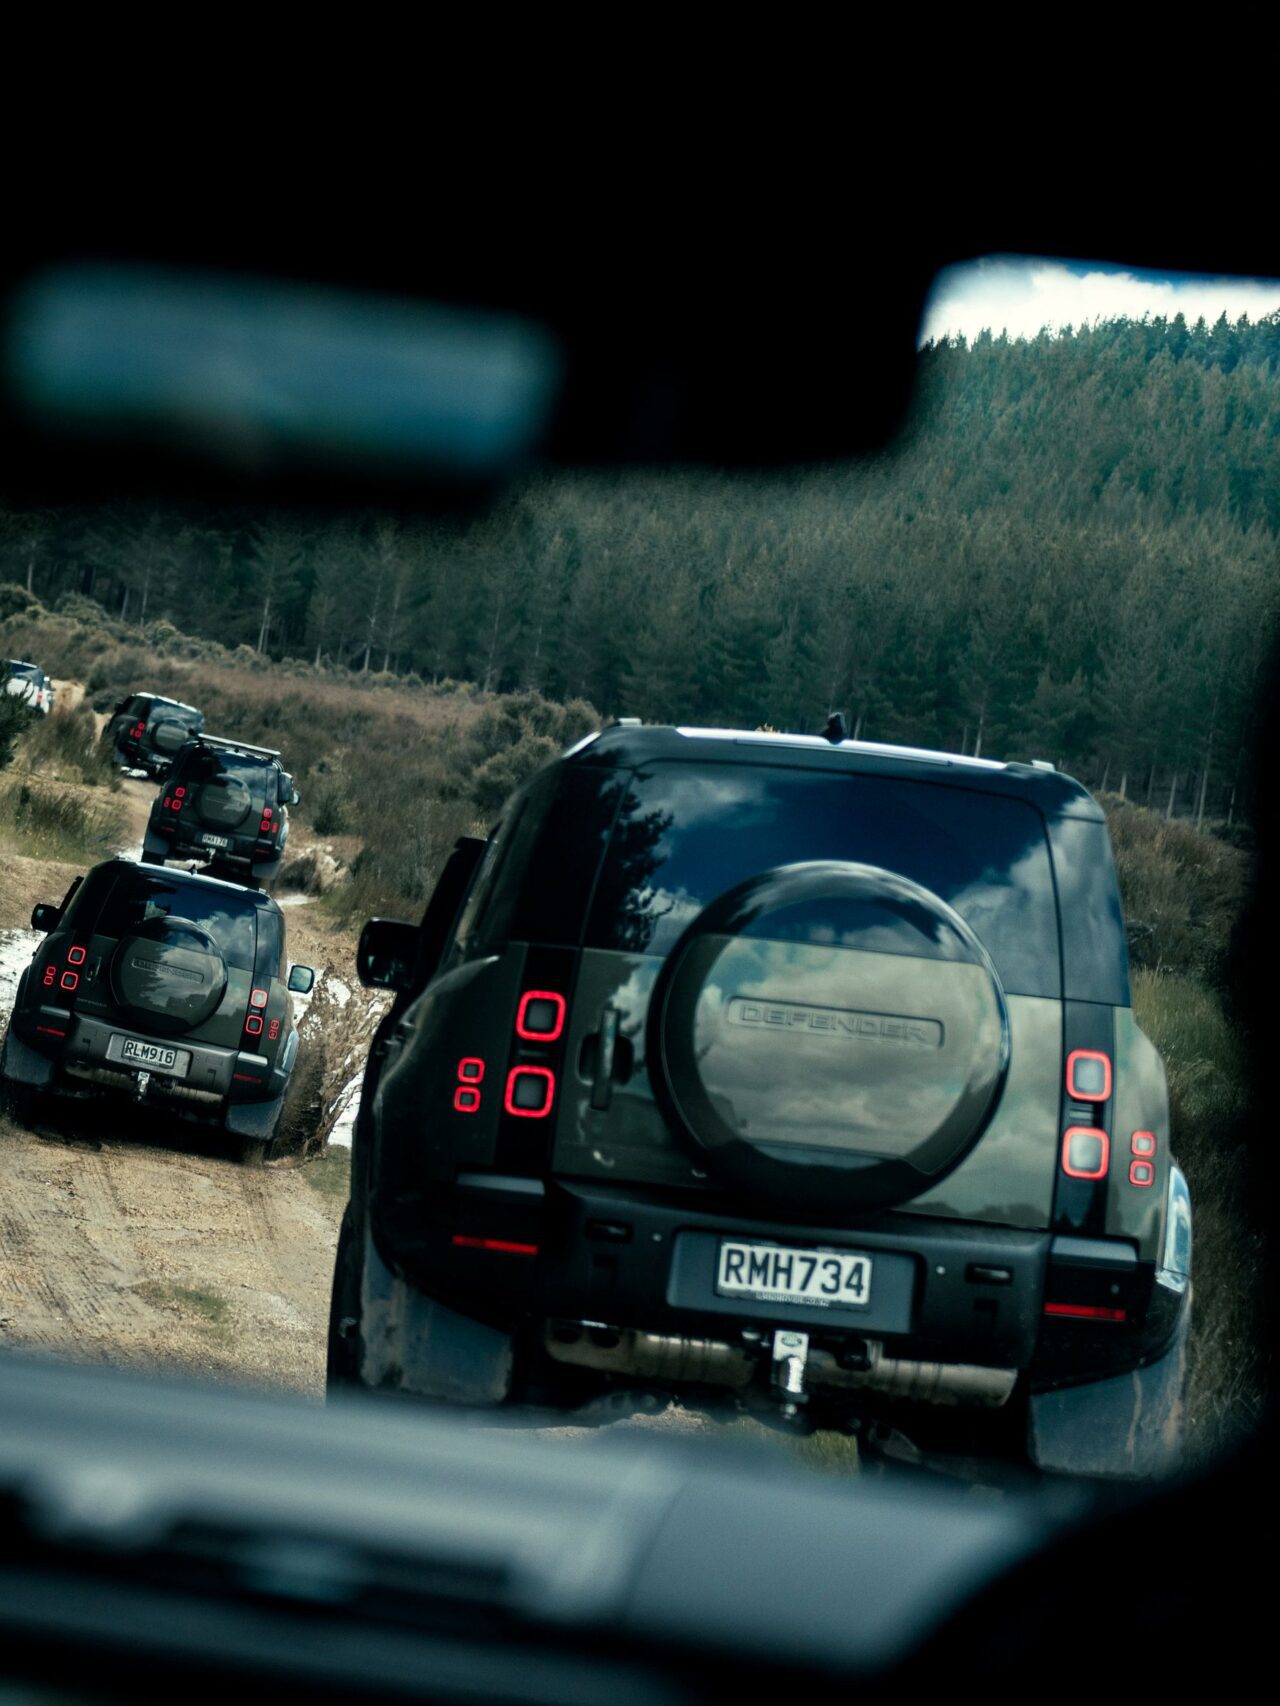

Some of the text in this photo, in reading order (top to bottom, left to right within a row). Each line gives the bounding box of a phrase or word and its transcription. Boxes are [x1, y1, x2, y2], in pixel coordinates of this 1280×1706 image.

[741, 1003, 927, 1042] DEFENDER
[125, 1041, 173, 1064] RLM916
[724, 1249, 865, 1297] RMH734
